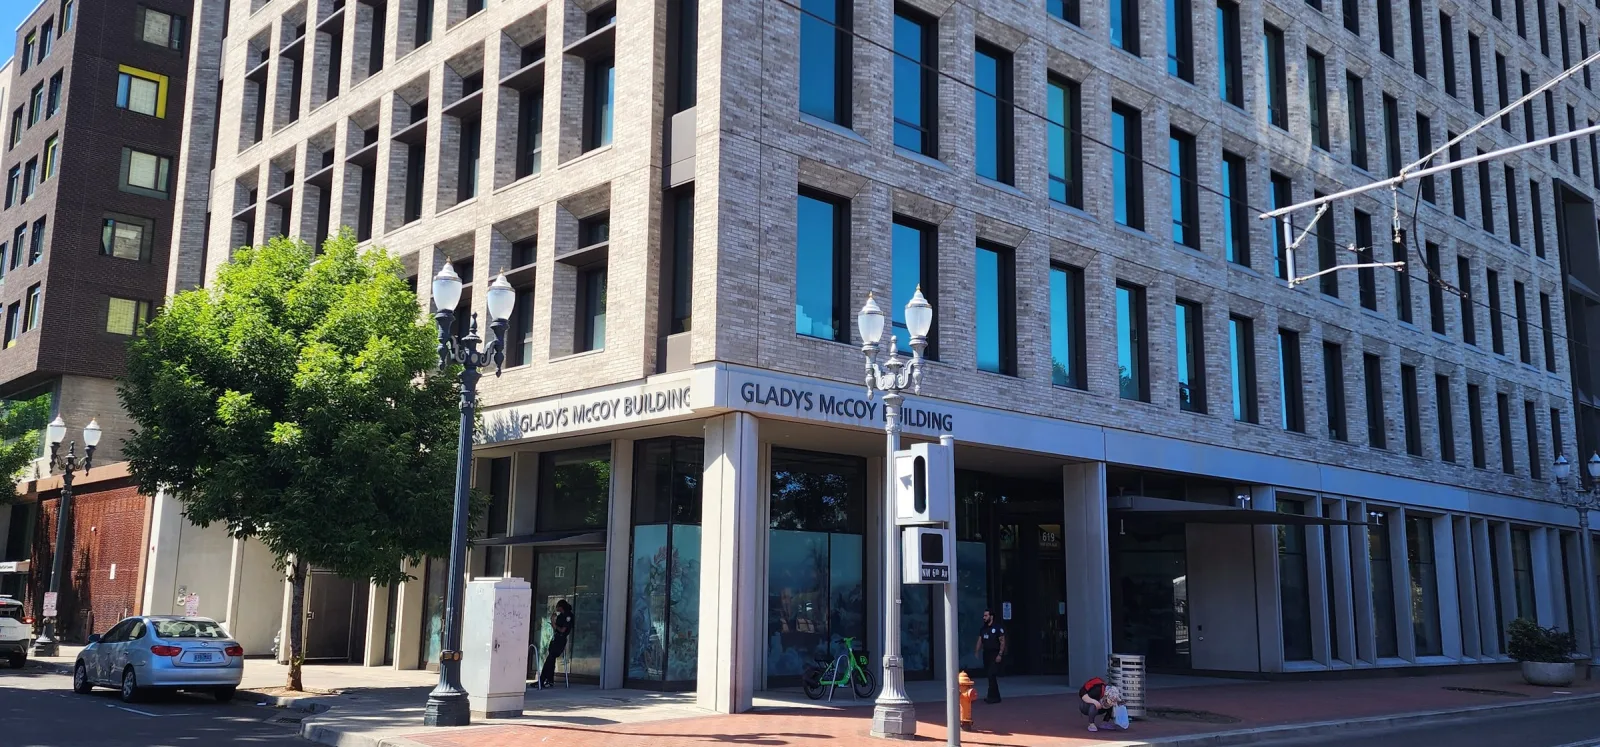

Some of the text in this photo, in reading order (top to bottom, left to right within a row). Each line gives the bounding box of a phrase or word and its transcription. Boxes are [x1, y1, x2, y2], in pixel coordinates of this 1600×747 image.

[520, 407, 569, 433] GLADYS
[573, 398, 620, 425] McCOY
[741, 382, 953, 432] GLADYS McCOY ILDING
[1042, 532, 1055, 542] 619
[922, 568, 931, 578] NW
